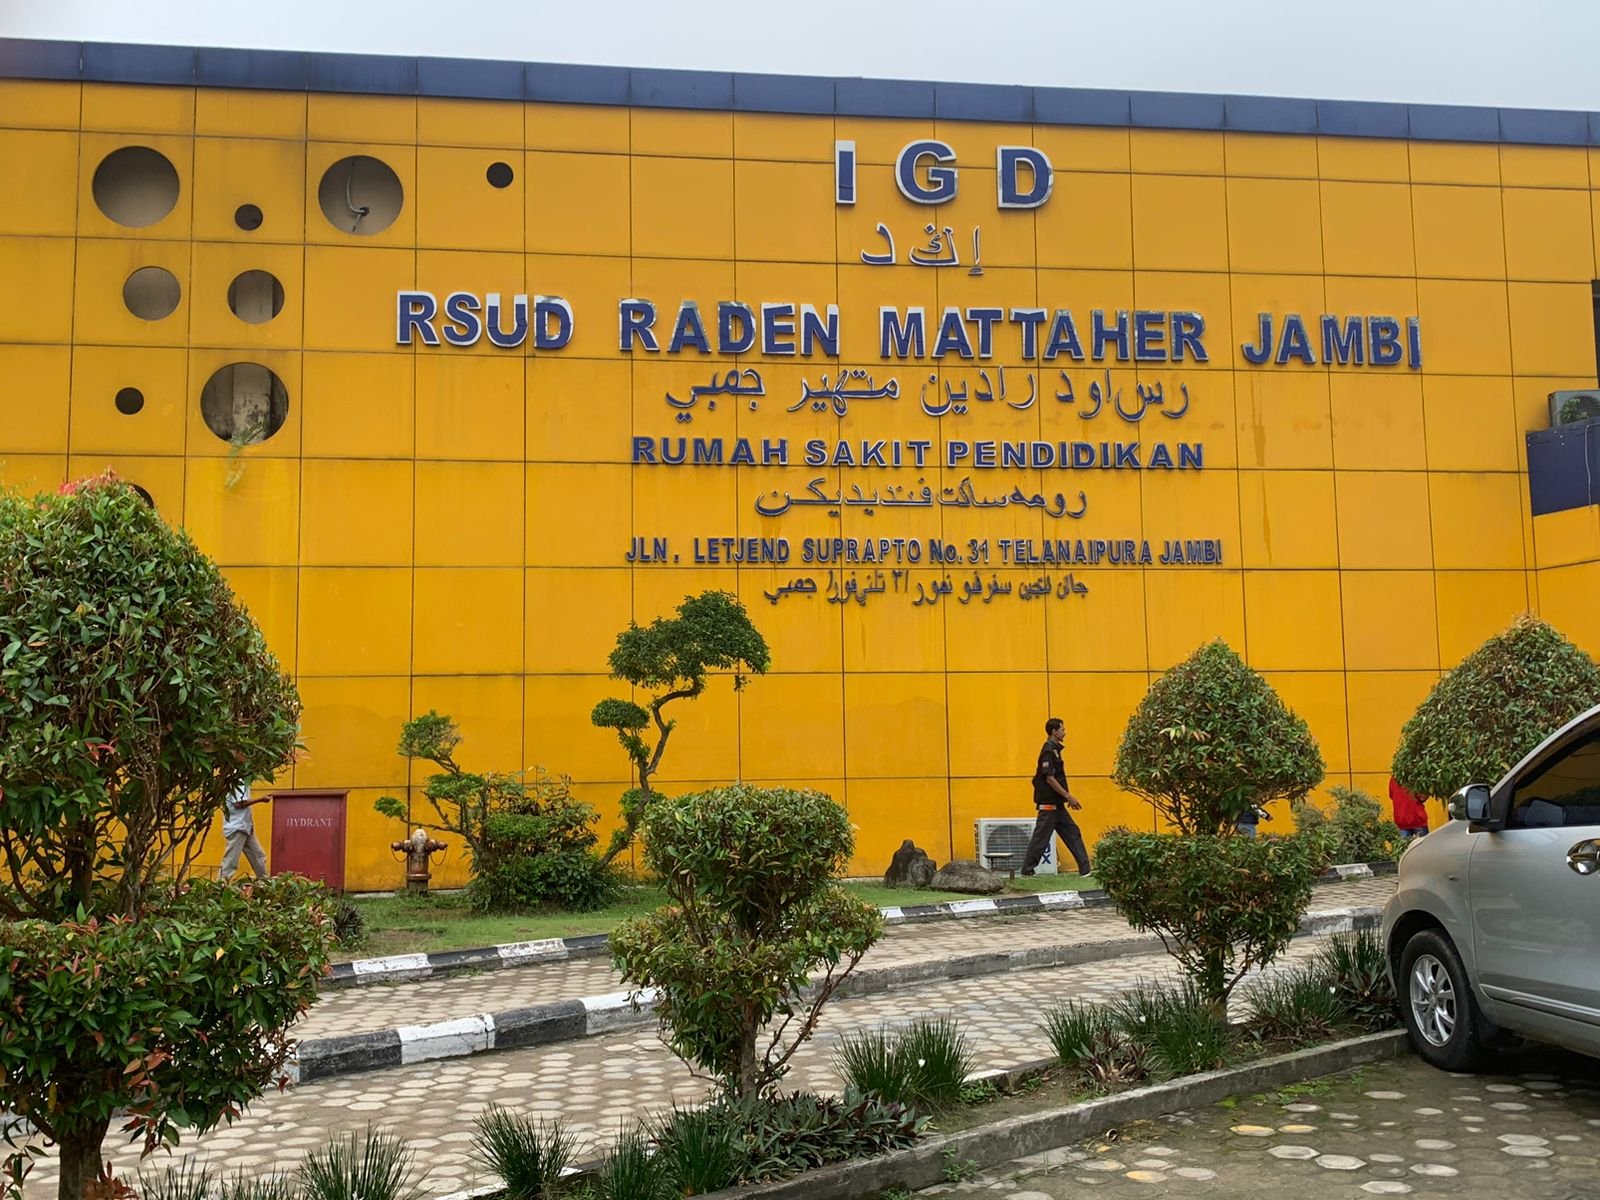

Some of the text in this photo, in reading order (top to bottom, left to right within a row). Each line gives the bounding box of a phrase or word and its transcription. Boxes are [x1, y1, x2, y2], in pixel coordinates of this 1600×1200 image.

[396, 290, 1422, 370] RSUD RADEN MATTAHER JAMBI
[632, 436, 1204, 470] RUMAH SAKIT PENDIDIKAN
[693, 536, 790, 564] LETJEND
[801, 537, 922, 565] SUPRAPTO
[998, 539, 1153, 566] TELANAIPURA
[1159, 539, 1222, 566] JAMBI
[286, 817, 333, 828] HYDRANT
